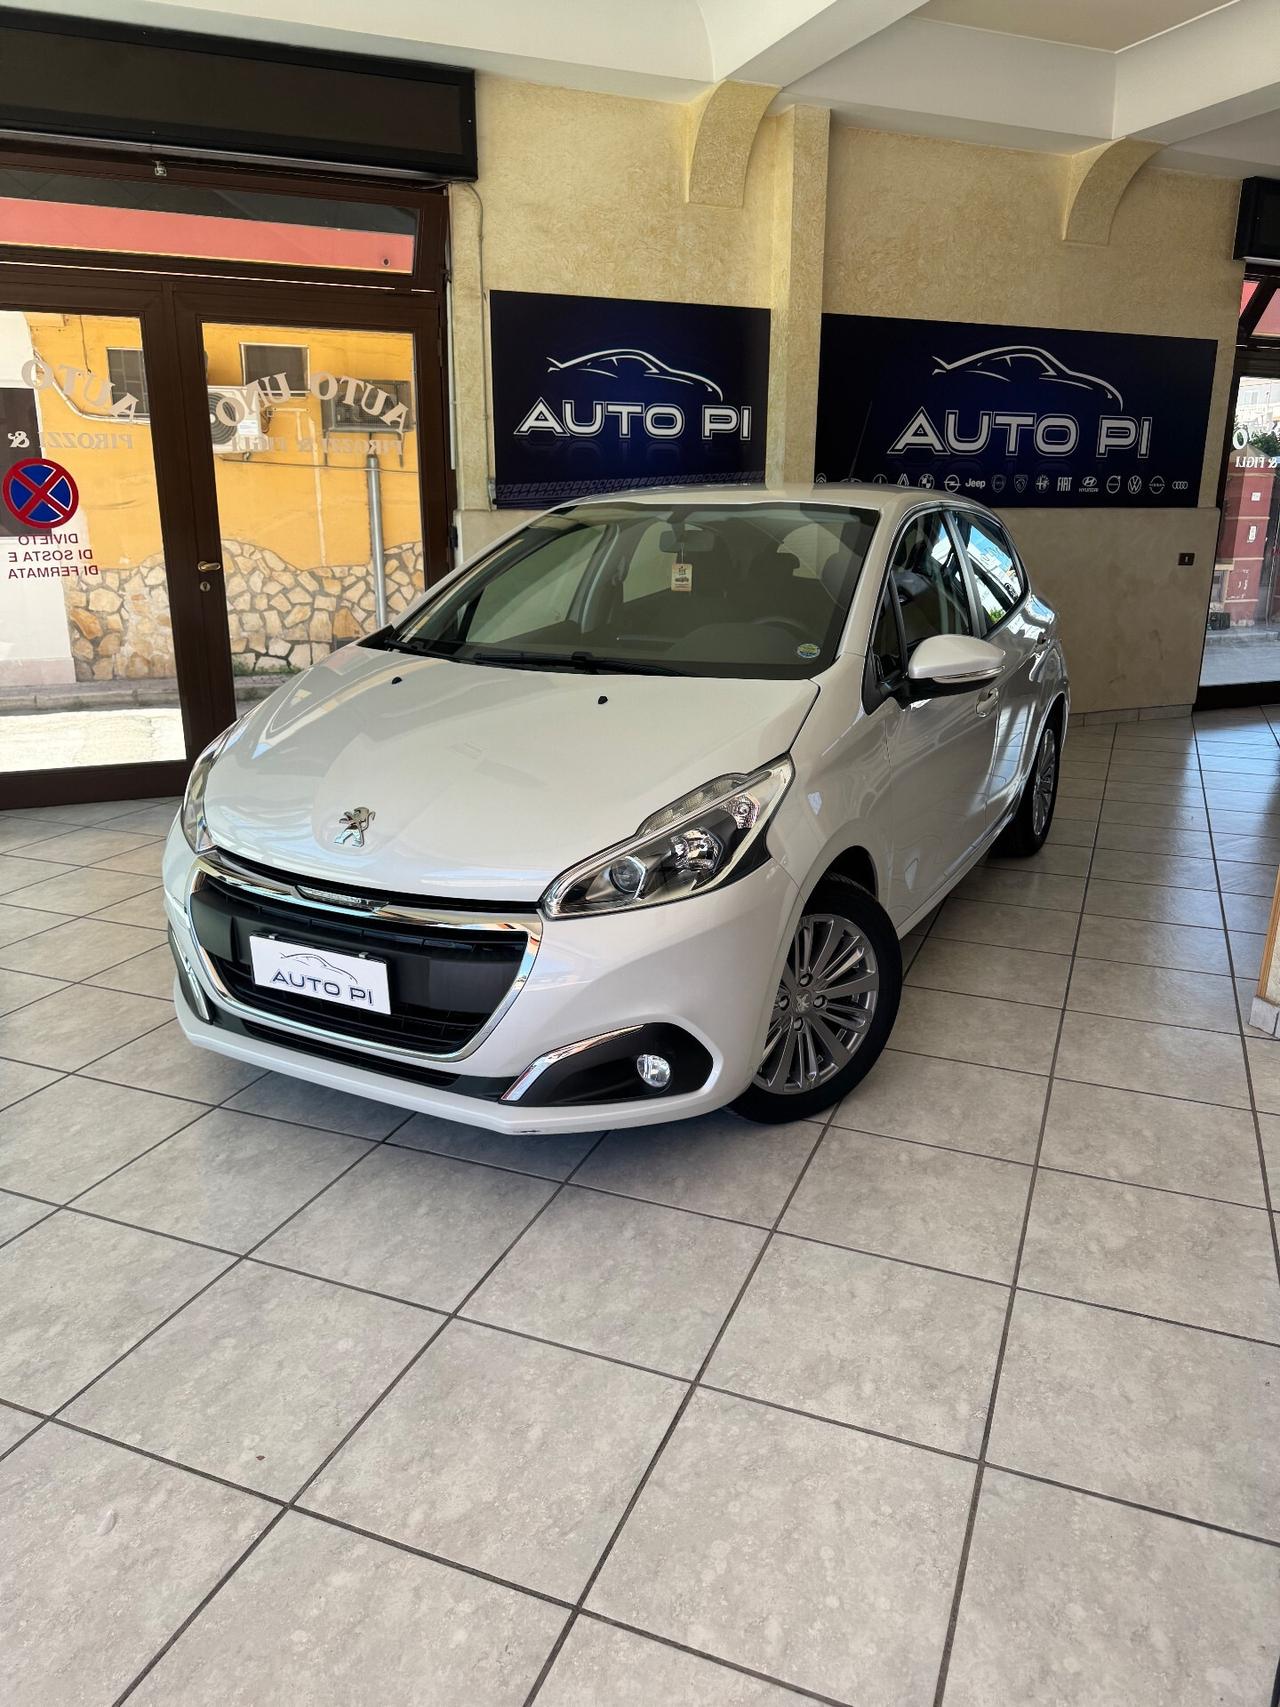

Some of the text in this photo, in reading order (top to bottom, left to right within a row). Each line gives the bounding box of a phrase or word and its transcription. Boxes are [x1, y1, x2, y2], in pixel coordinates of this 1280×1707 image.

[513, 397, 752, 440] AUTO PI
[887, 406, 1152, 458] AUTO PI
[965, 478, 986, 489] Jeep
[1057, 476, 1073, 492] FIAT
[271, 970, 373, 1005] AUTO PI
